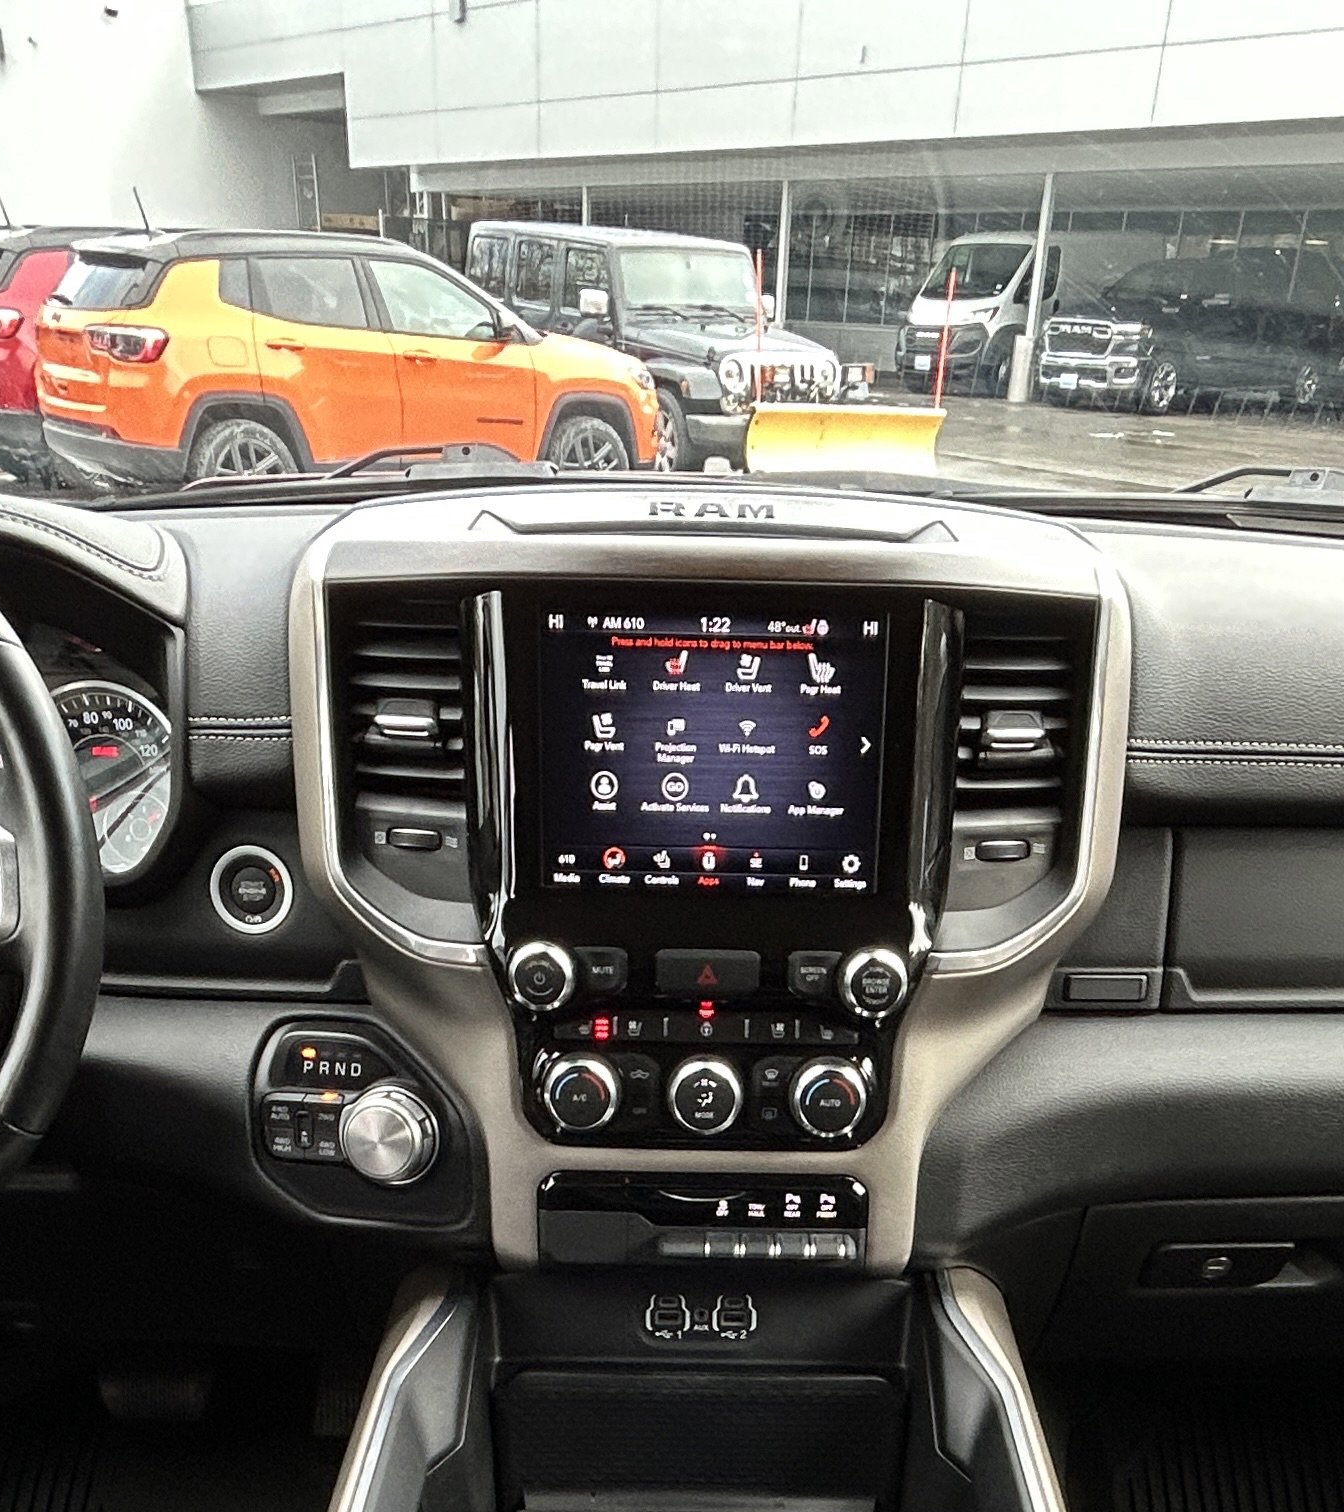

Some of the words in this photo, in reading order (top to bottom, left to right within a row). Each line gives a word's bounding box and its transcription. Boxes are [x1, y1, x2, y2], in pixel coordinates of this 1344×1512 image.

[648, 501, 775, 519] RAM
[548, 613, 564, 629] HI
[602, 616, 622, 629] AM
[623, 616, 645, 630] 610
[700, 616, 732, 633] 1:22
[862, 620, 879, 636] HI
[611, 636, 634, 647] Press
[635, 636, 653, 647] and
[654, 637, 673, 648] hold
[675, 637, 698, 648] icons
[699, 639, 708, 648] to
[711, 639, 730, 650] drag
[732, 640, 741, 649] to
[743, 641, 768, 650] menu
[770, 640, 785, 650] bar
[608, 679, 627, 691] Link
[652, 680, 679, 692] Driver
[82, 711, 99, 724] 80
[113, 718, 134, 731] 100
[139, 744, 158, 757] 120
[808, 744, 829, 755] SOS
[592, 966, 615, 974] MUTE
[800, 966, 827, 975] SCREEN
[303, 1060, 314, 1074] P
[319, 1061, 330, 1075] R
[335, 1062, 347, 1076] N
[351, 1063, 362, 1077] D
[820, 1098, 841, 1107] AUTO
[739, 1329, 748, 1340] 2
